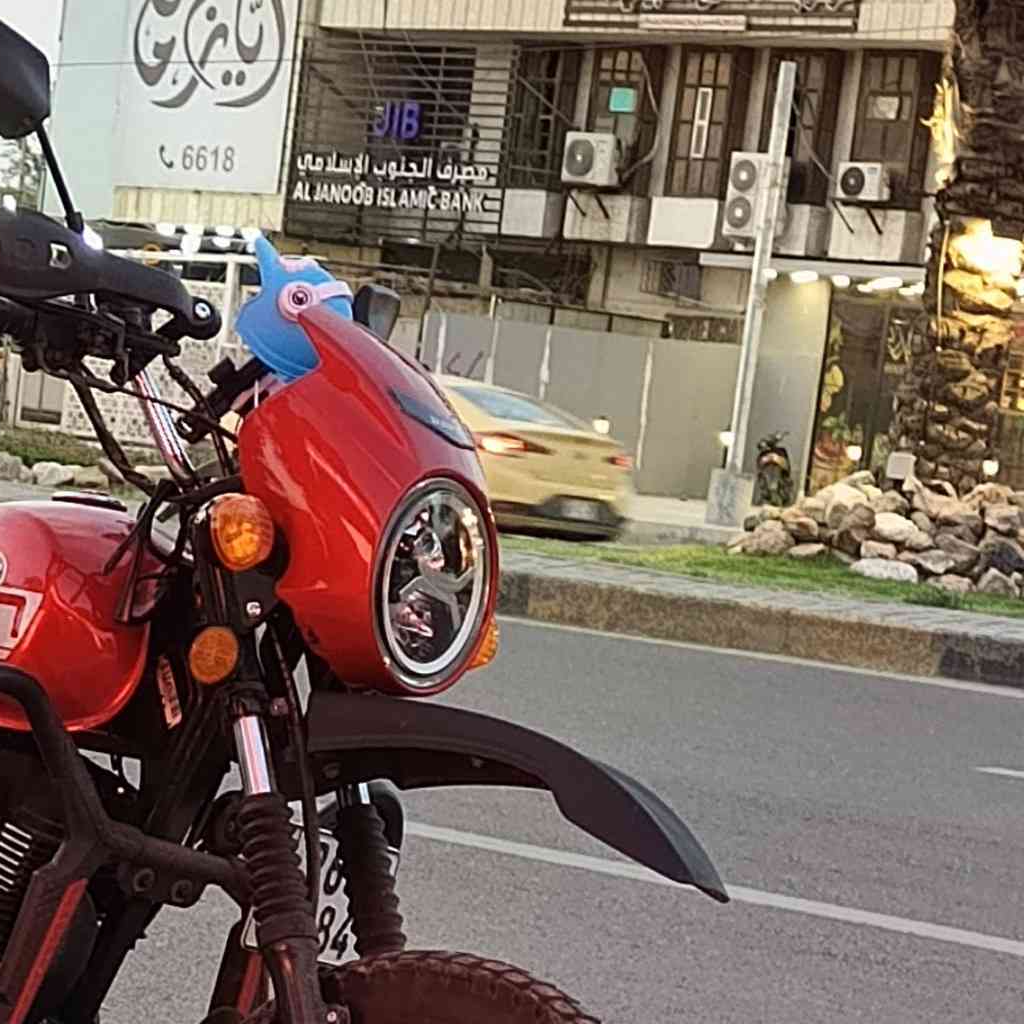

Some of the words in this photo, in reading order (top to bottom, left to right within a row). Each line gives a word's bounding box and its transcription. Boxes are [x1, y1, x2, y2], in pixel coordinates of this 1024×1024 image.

[182, 145, 235, 172] 6618
[372, 155, 433, 183] الجنوب
[436, 156, 489, 185] مصرف
[292, 180, 311, 201] AL
[313, 181, 374, 206] JANOOB
[376, 186, 437, 210] ISLAMIC
[439, 190, 486, 214] BANK
